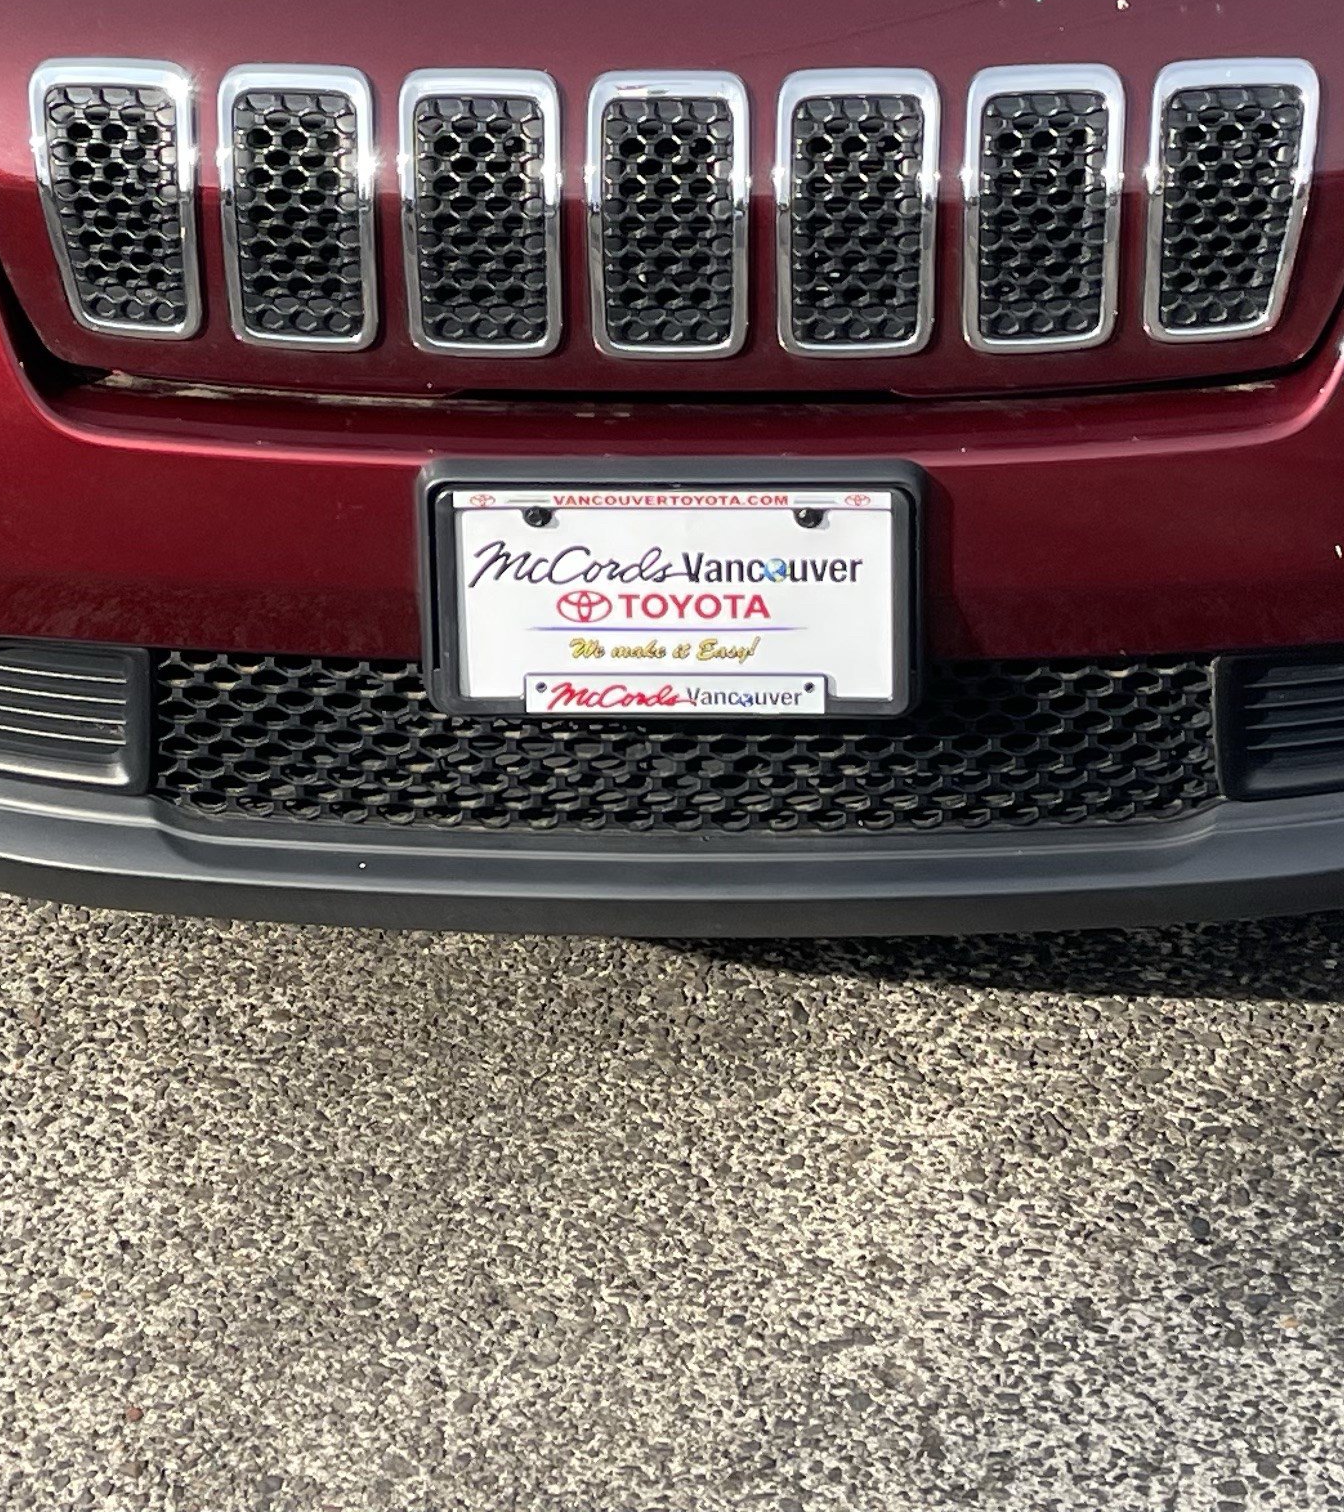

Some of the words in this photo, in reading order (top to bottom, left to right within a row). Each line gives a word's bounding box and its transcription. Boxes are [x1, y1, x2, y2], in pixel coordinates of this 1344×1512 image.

[552, 494, 789, 507] VANCOUVERTOYOTA.COM
[468, 540, 686, 588] McCords
[681, 551, 864, 583] Vancouver
[618, 593, 771, 619] TOYOTA
[569, 637, 605, 659] We
[610, 639, 666, 659] make
[672, 640, 691, 659] it
[696, 636, 761, 664] Easy!
[547, 682, 686, 710] McCords
[684, 687, 804, 707] Vancouver
